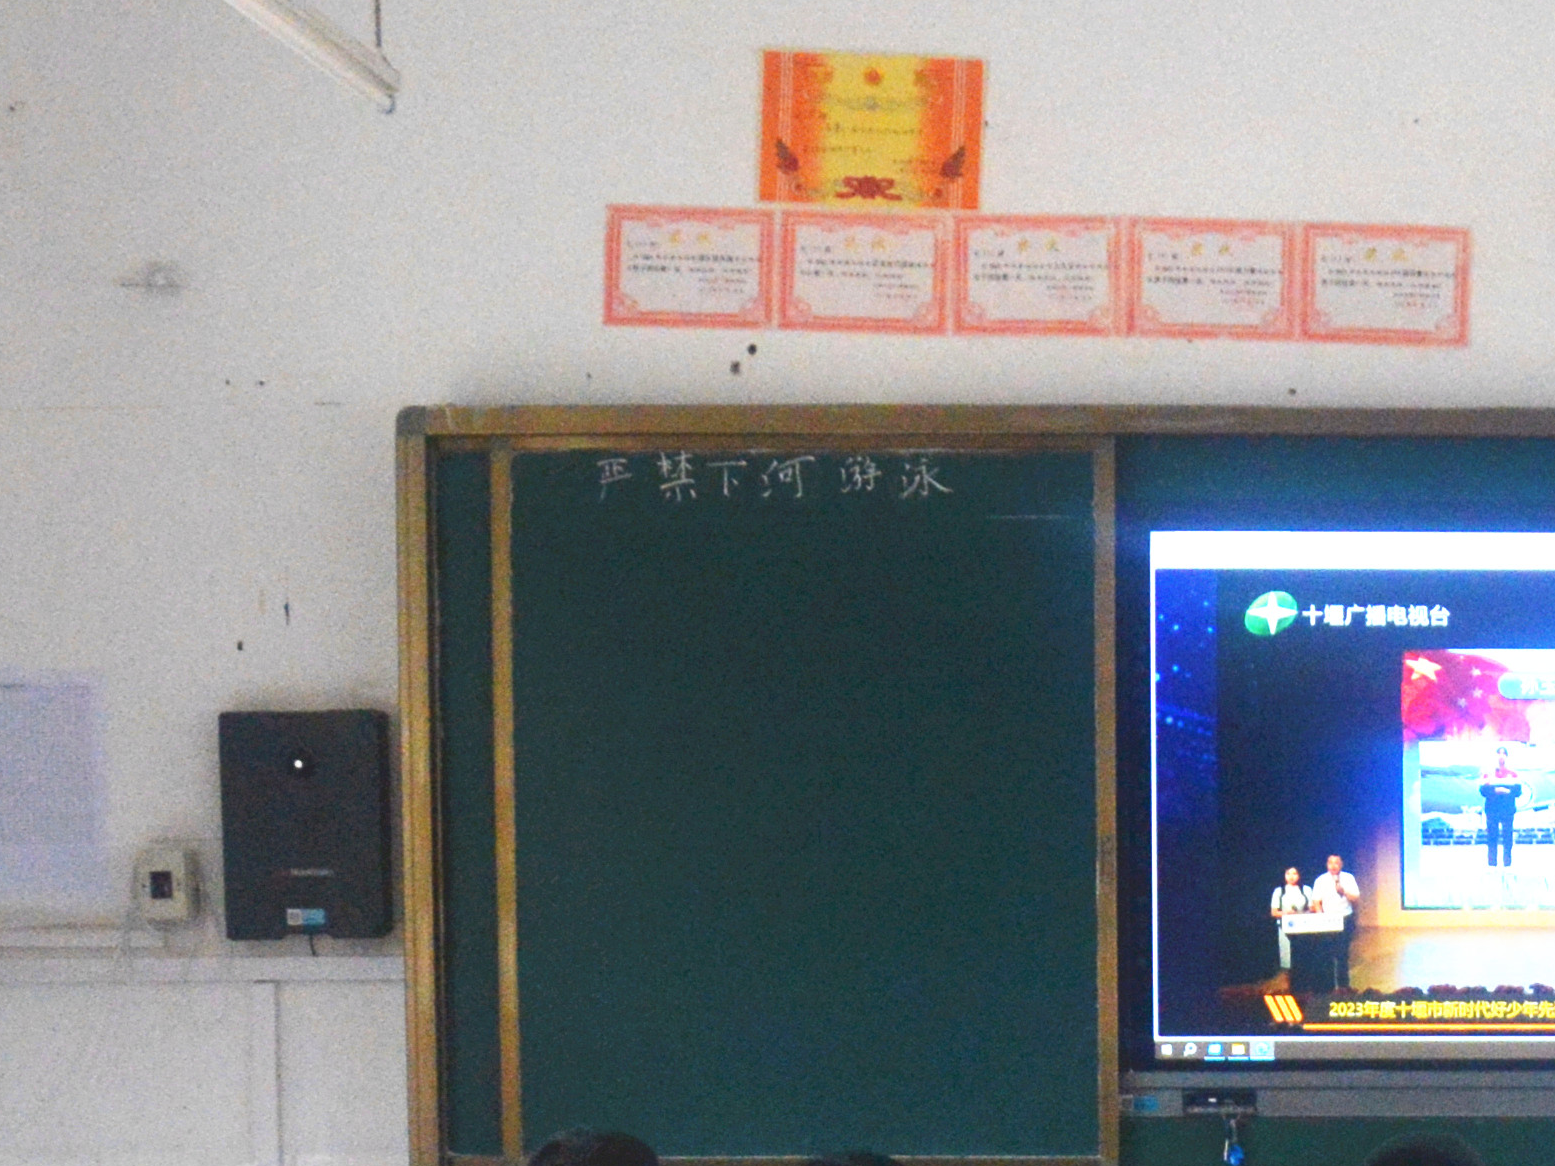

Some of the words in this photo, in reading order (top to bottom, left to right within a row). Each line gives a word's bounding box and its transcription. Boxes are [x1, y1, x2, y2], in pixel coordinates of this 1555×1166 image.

[596, 450, 953, 501] 严禁下河游泳
[1302, 603, 1450, 627] 十堰广播电视台
